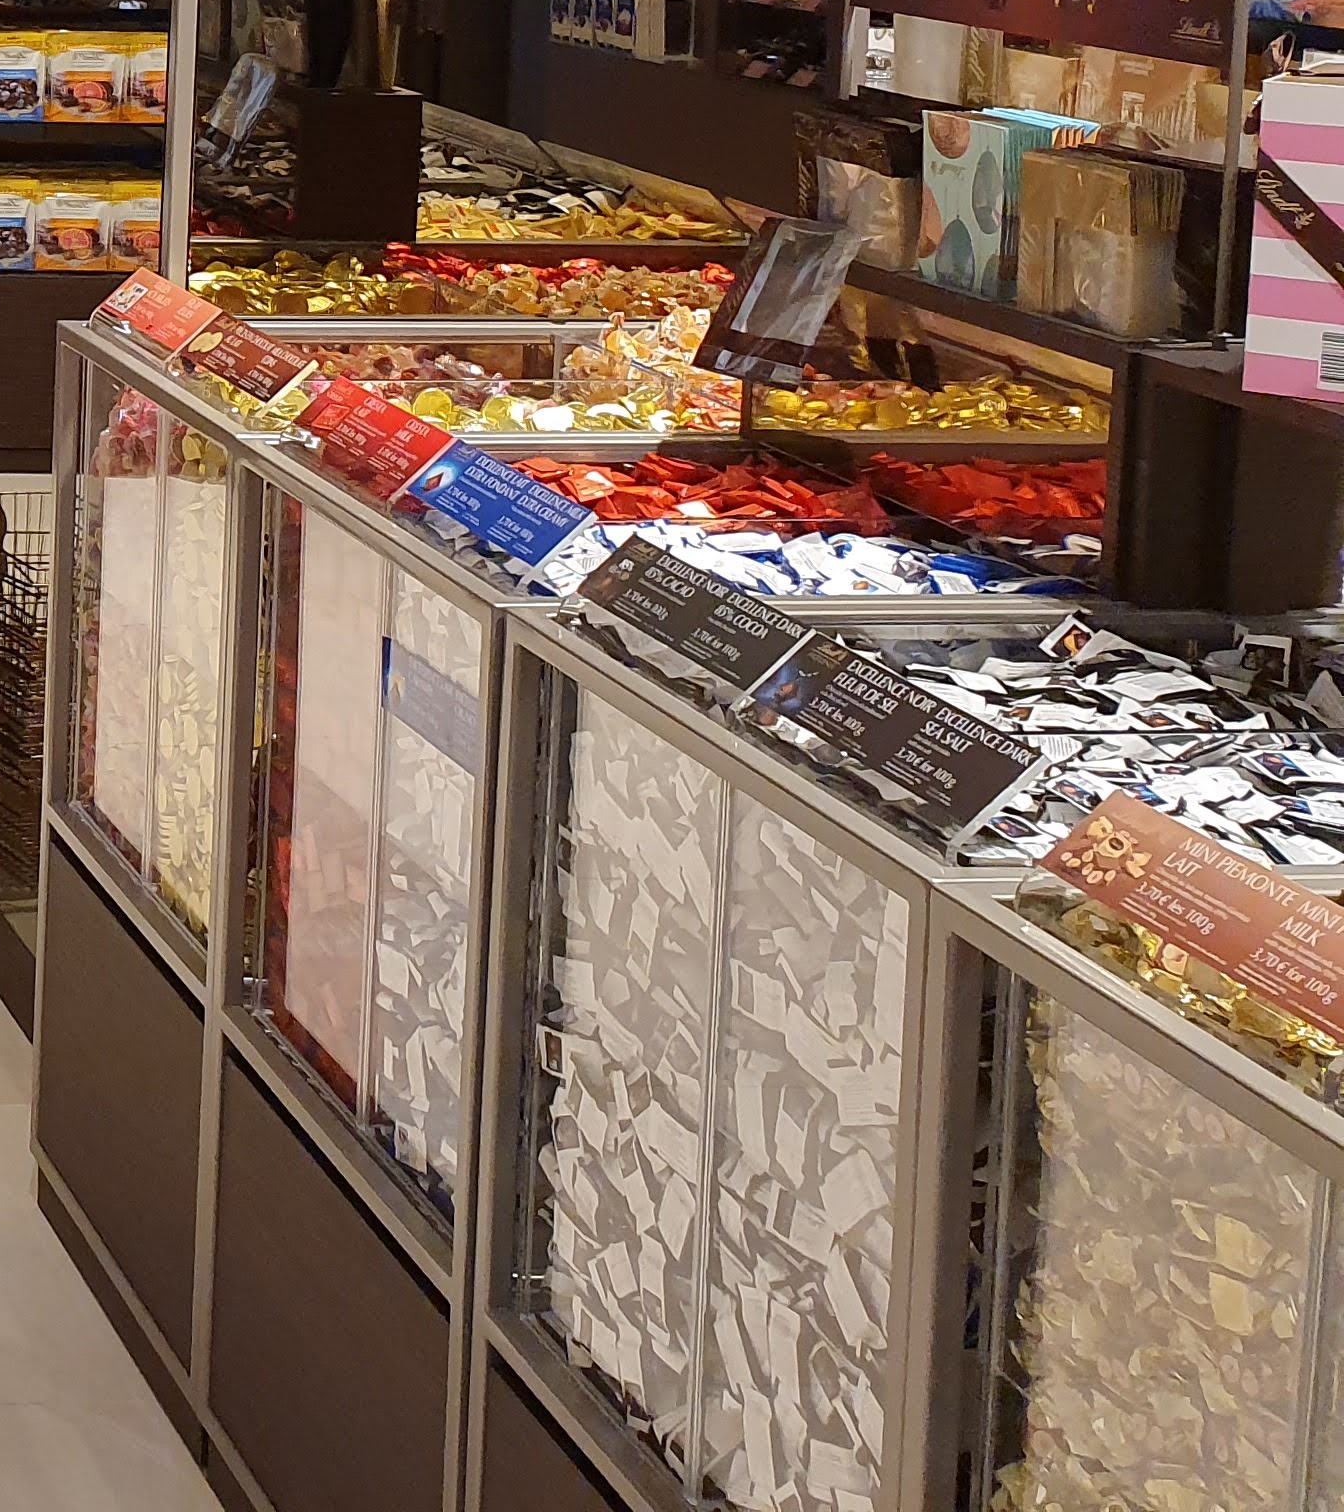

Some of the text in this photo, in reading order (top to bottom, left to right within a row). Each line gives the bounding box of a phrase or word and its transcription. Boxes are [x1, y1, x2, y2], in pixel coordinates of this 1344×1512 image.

[1255, 169, 1304, 212] Lindt
[475, 455, 531, 489] EXCELLENCE LAIT
[528, 485, 571, 512] EXCELLENCE
[656, 554, 707, 589] EXCELLENCE
[702, 579, 729, 599] NOIR
[661, 575, 696, 599] CACAO
[726, 592, 807, 640] EXCELLENCE DARK
[732, 614, 769, 640] COCOA
[832, 671, 867, 696] FLEUR
[862, 686, 883, 706] DE
[878, 696, 900, 715] SEL
[846, 659, 909, 700] EXCELLENCE
[903, 687, 938, 714] NOIR
[830, 708, 845, 723] les
[842, 715, 866, 737] 100g
[919, 719, 975, 755] SEA SALT
[935, 705, 1038, 768] EXCELLENCE DARK
[919, 759, 936, 776] for
[933, 765, 958, 790] 100g
[1163, 851, 1203, 879] LAIT
[1179, 837, 1221, 867] MINI
[1215, 854, 1300, 908] PIEMONTE
[1166, 898, 1186, 916] les
[1184, 907, 1217, 937] 100g
[1279, 915, 1327, 948] MILK
[1296, 899, 1341, 931] MINI
[1285, 965, 1308, 984] for
[1304, 977, 1340, 1007] 100g
